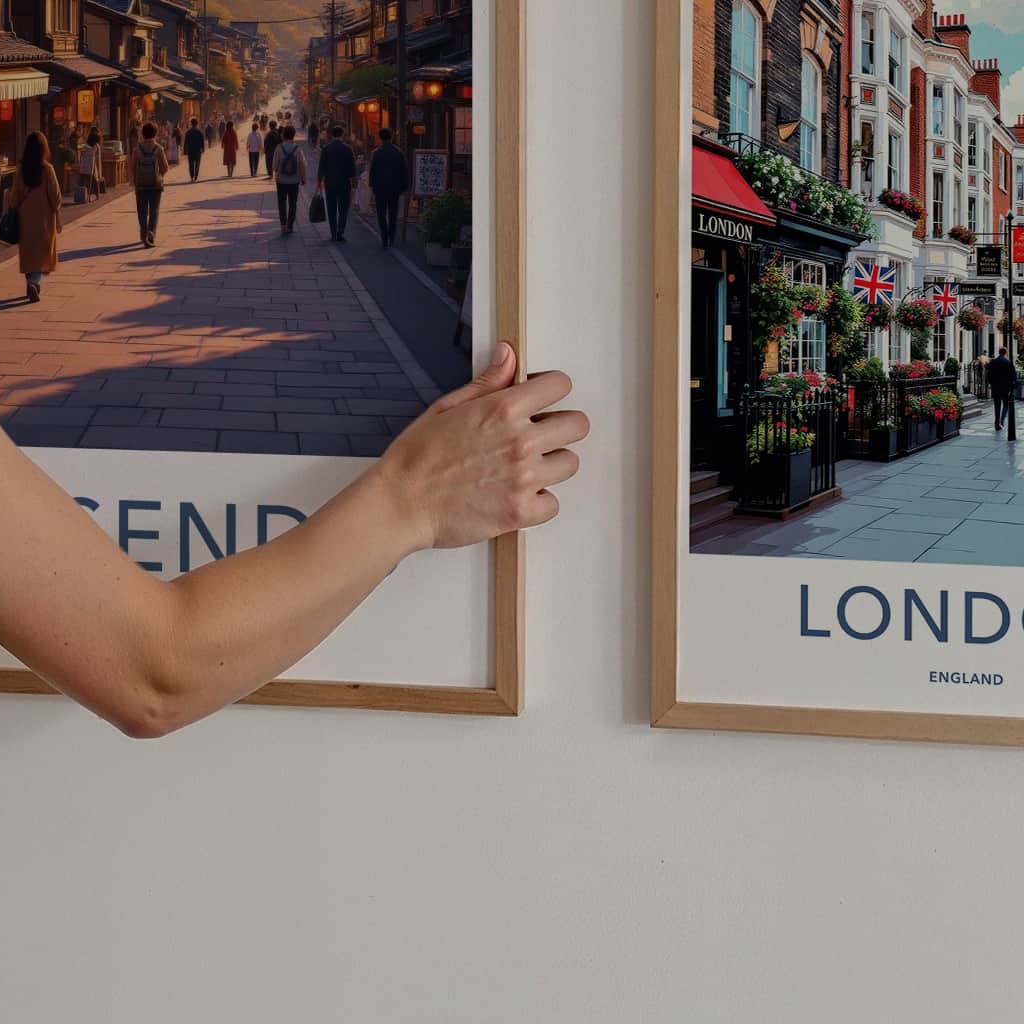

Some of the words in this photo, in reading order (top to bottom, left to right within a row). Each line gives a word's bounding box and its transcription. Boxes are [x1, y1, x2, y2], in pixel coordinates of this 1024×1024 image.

[698, 213, 753, 242] LONDON
[800, 584, 1024, 644] LOND
[929, 671, 1004, 685] ENGLAND
